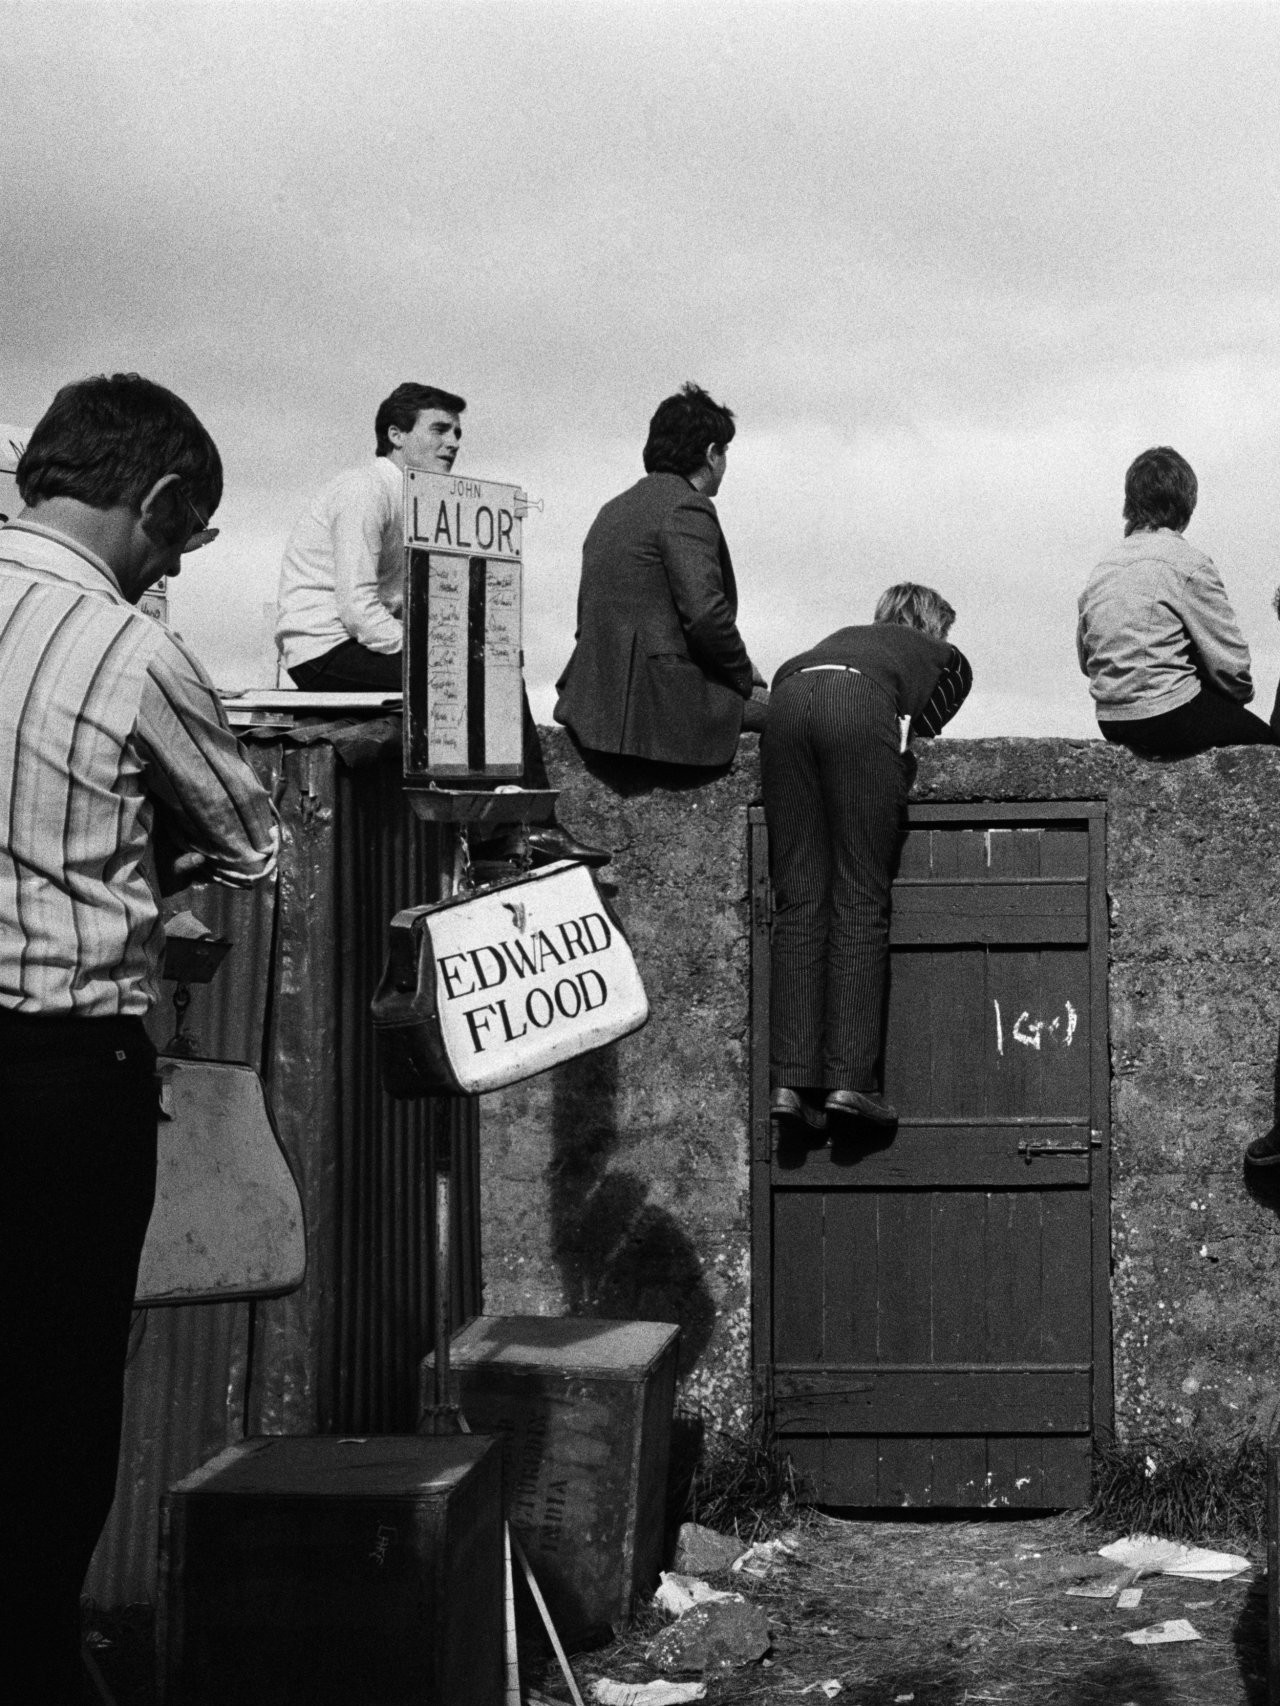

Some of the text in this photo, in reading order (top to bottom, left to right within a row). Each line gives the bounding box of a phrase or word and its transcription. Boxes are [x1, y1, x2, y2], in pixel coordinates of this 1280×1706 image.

[413, 496, 514, 552] LALOR
[450, 480, 481, 498] JOHN
[437, 913, 612, 1000] EDWARD
[463, 969, 608, 1054] FLOOD
